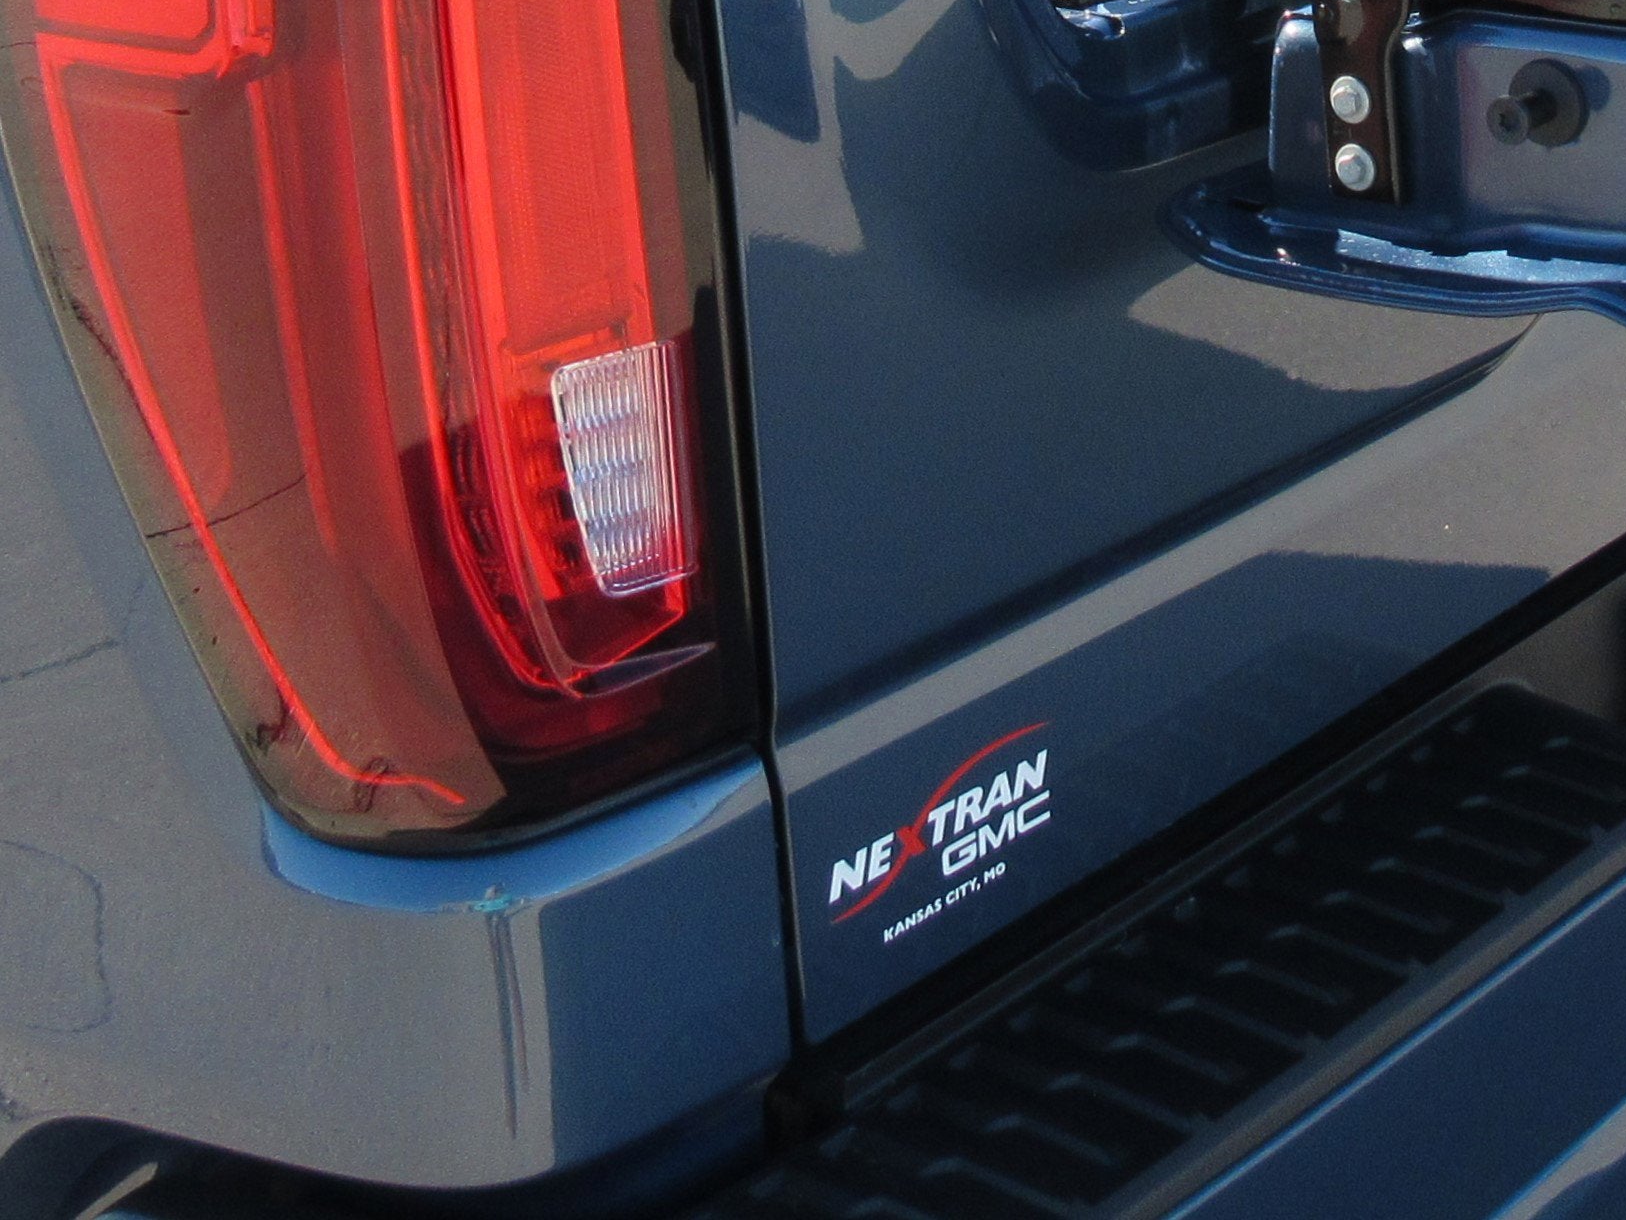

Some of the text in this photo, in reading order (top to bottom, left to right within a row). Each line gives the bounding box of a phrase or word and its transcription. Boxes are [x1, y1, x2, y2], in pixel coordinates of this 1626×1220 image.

[829, 749, 1048, 905] NEXTRAN
[941, 789, 1051, 877] GMC
[883, 861, 1007, 943] KANSAS CITY, MO
